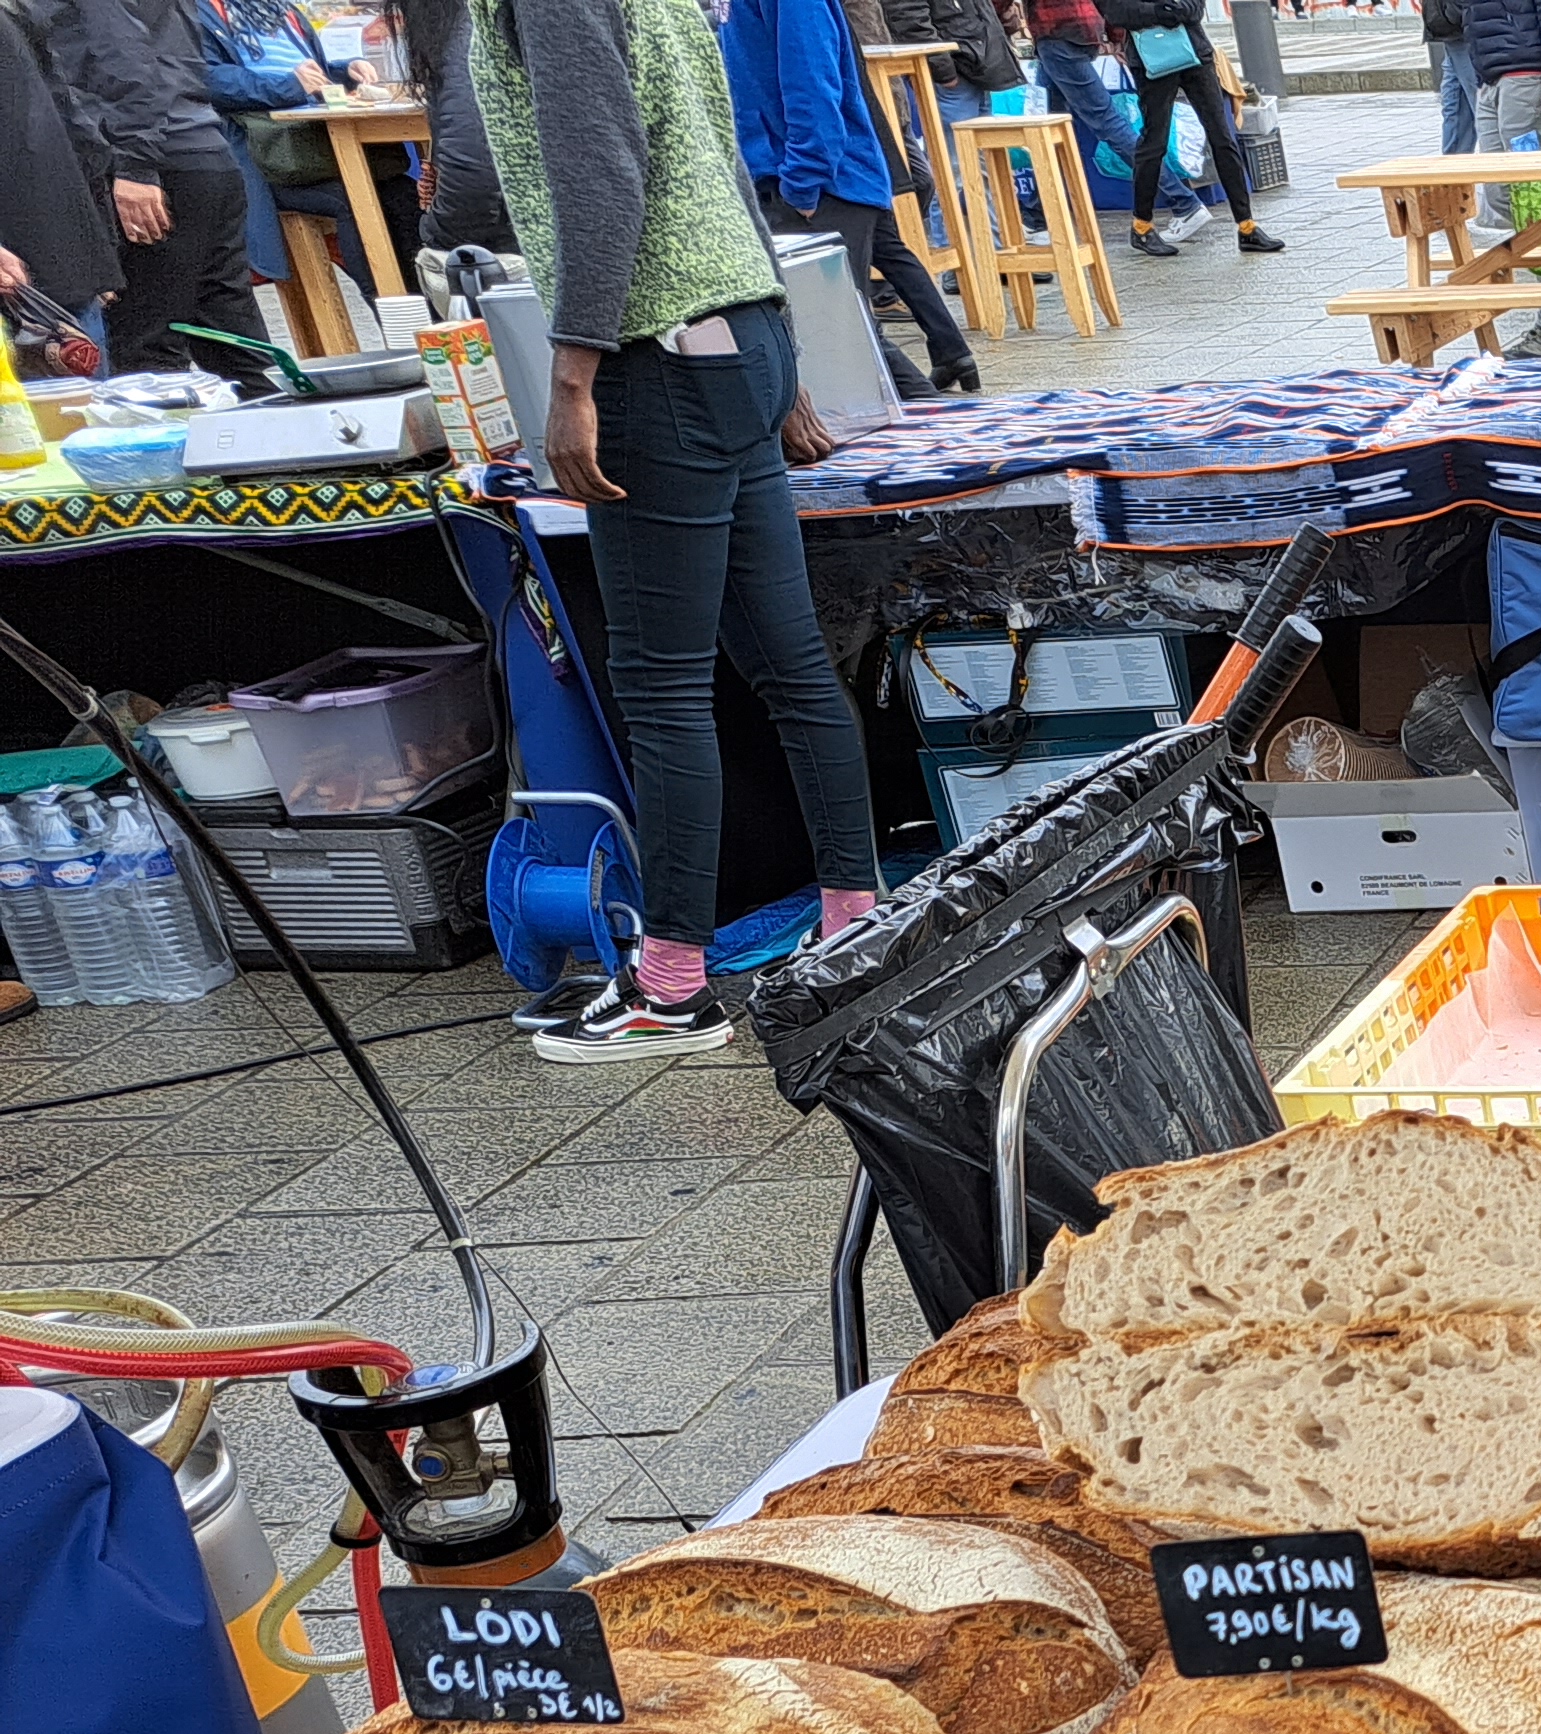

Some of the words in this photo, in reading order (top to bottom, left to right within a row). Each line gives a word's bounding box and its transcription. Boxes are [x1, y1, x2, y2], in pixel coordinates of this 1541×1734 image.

[1362, 889, 1390, 897] FRANCE
[440, 1605, 561, 1648] LODI
[1205, 1597, 1362, 1650] 7,90€/kg
